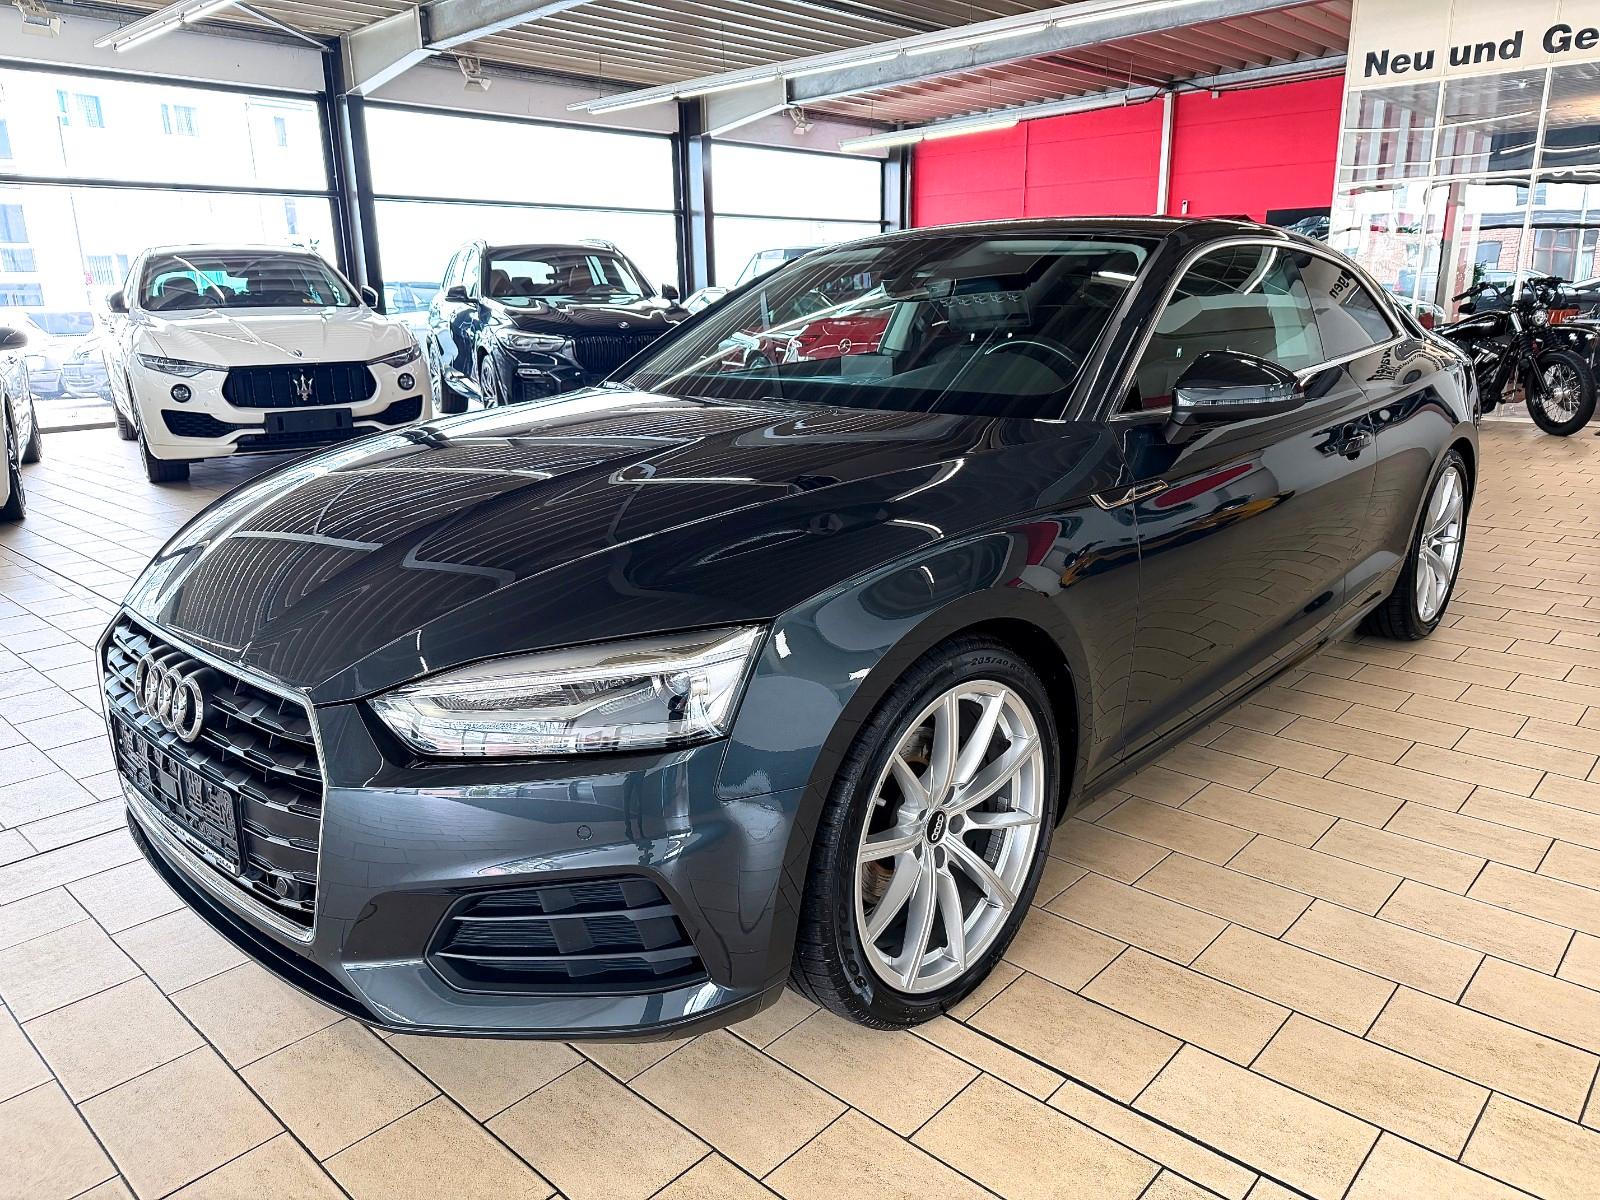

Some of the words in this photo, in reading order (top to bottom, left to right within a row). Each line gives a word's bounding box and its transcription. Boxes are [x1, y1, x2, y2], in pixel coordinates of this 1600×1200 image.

[1364, 49, 1436, 78] Neu
[1449, 30, 1524, 67] und
[1542, 23, 1600, 54] Ge
